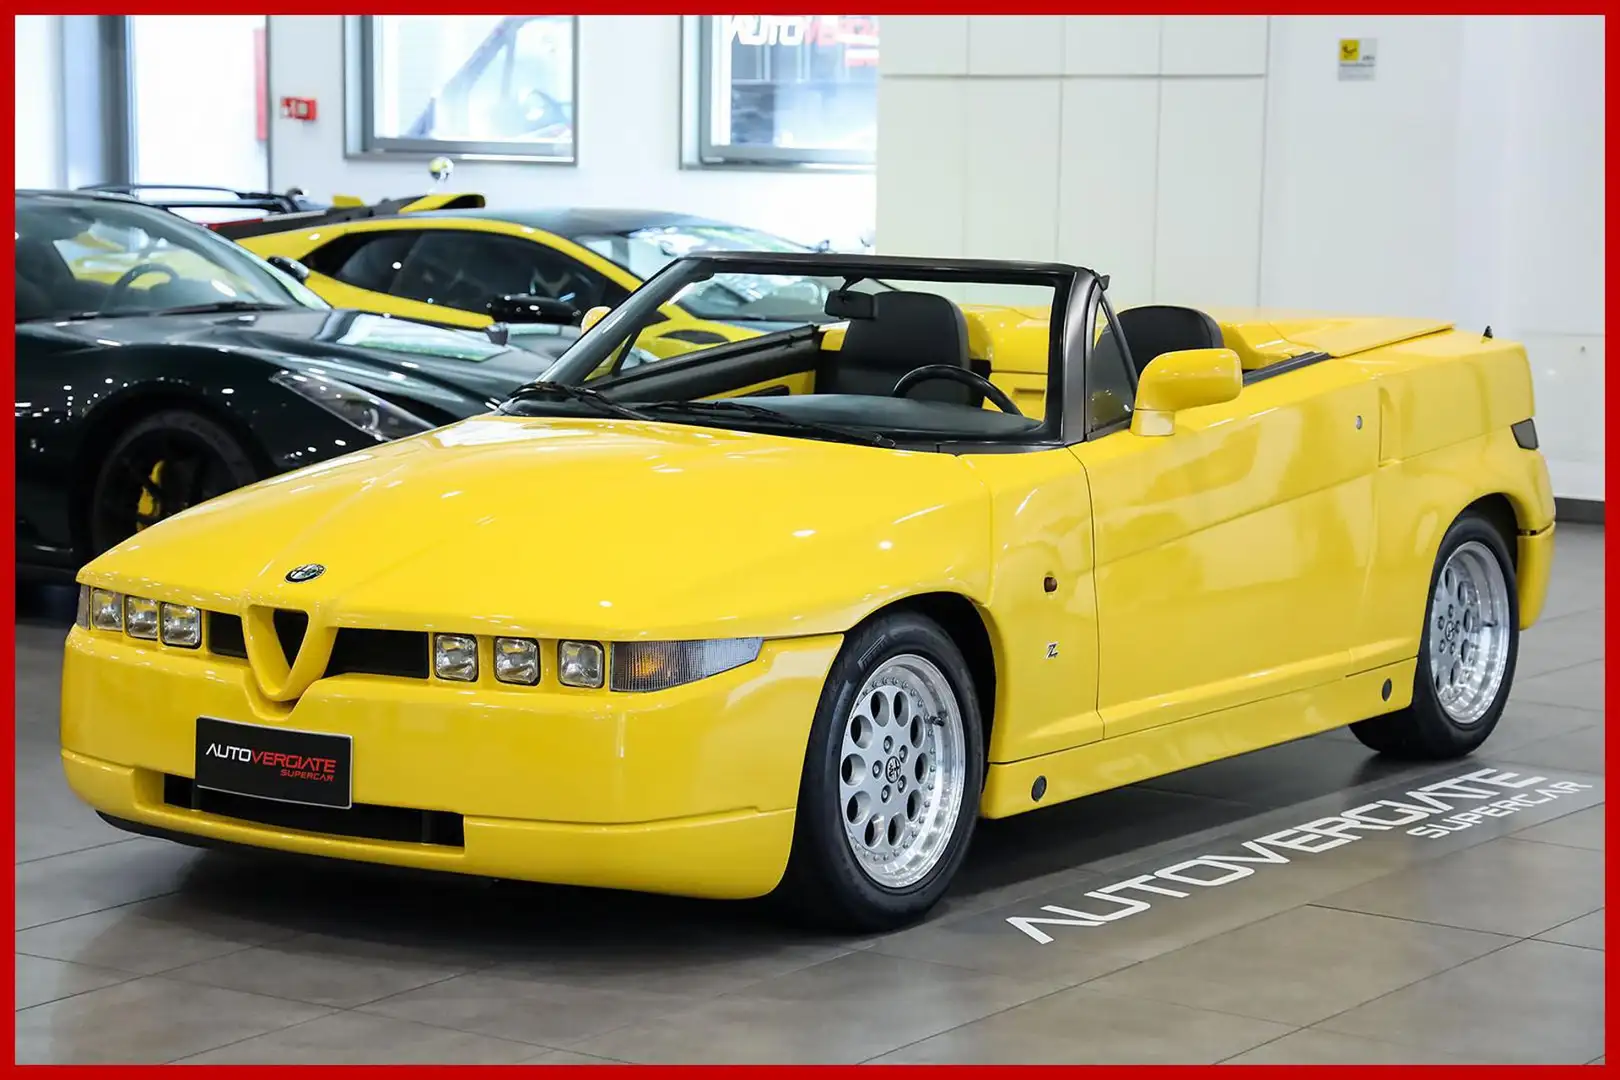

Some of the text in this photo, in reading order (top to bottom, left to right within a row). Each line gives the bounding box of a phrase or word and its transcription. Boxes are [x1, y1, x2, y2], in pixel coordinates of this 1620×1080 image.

[206, 743, 337, 773] AUTOVERGIATE
[280, 769, 334, 782] SUPERCAR
[1406, 781, 1593, 838] SUPERCAR
[1005, 767, 1548, 944] AUTOVERGIATE
